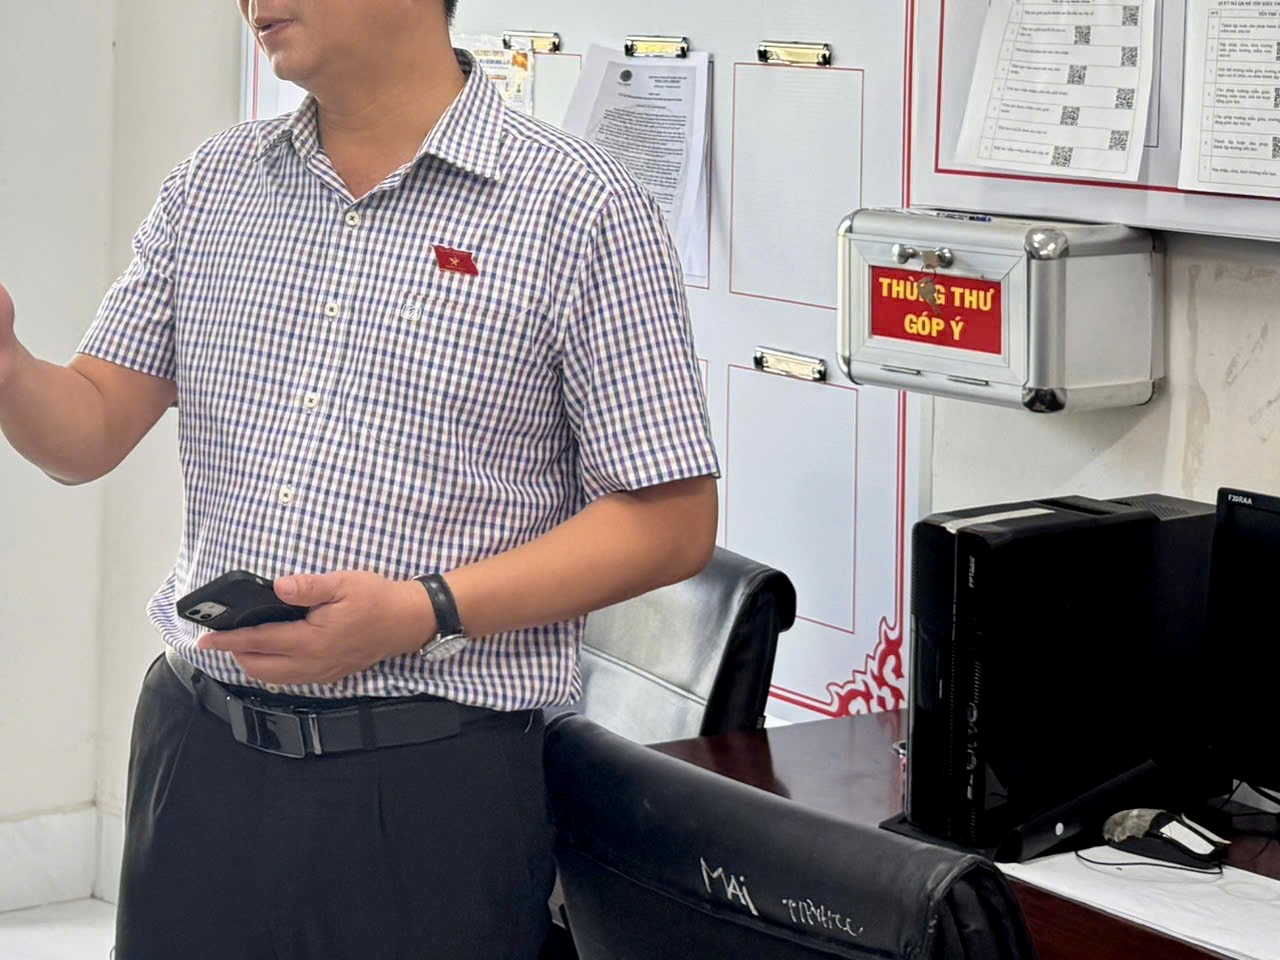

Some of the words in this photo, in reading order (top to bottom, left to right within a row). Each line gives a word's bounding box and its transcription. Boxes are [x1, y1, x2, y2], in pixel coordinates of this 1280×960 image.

[879, 276, 946, 305] THÙG
[950, 286, 994, 311] THƯ
[904, 314, 945, 338] GÓP
[950, 316, 965, 341] Ý
